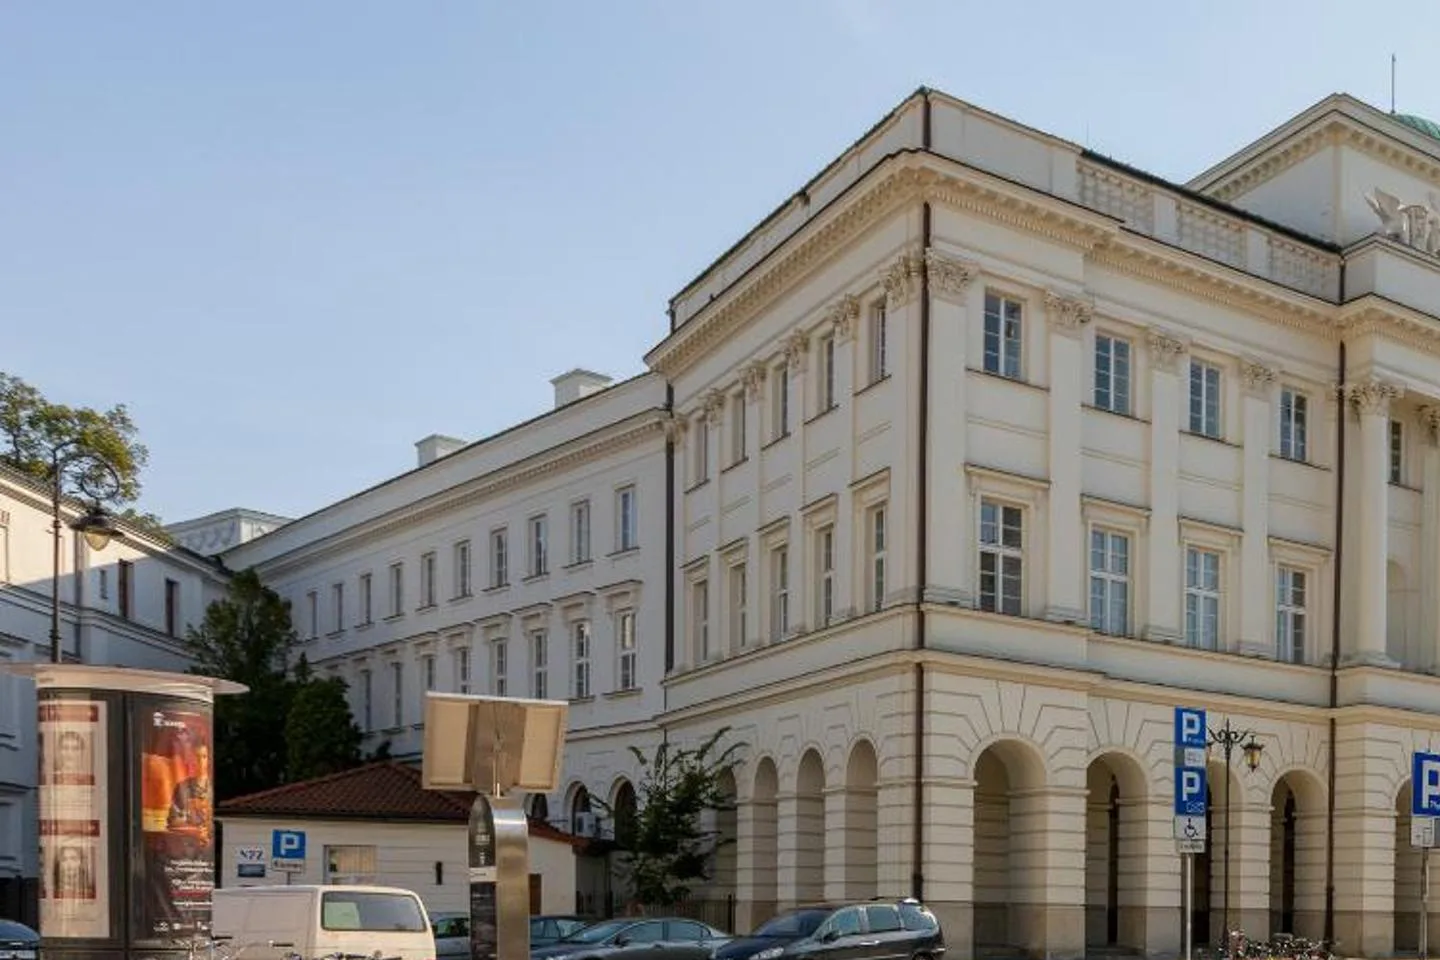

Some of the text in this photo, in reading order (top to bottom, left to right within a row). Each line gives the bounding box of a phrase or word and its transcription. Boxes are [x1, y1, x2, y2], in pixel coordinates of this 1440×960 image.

[1182, 711, 1201, 743] P
[1182, 771, 1201, 802] P
[280, 832, 300, 856] P
